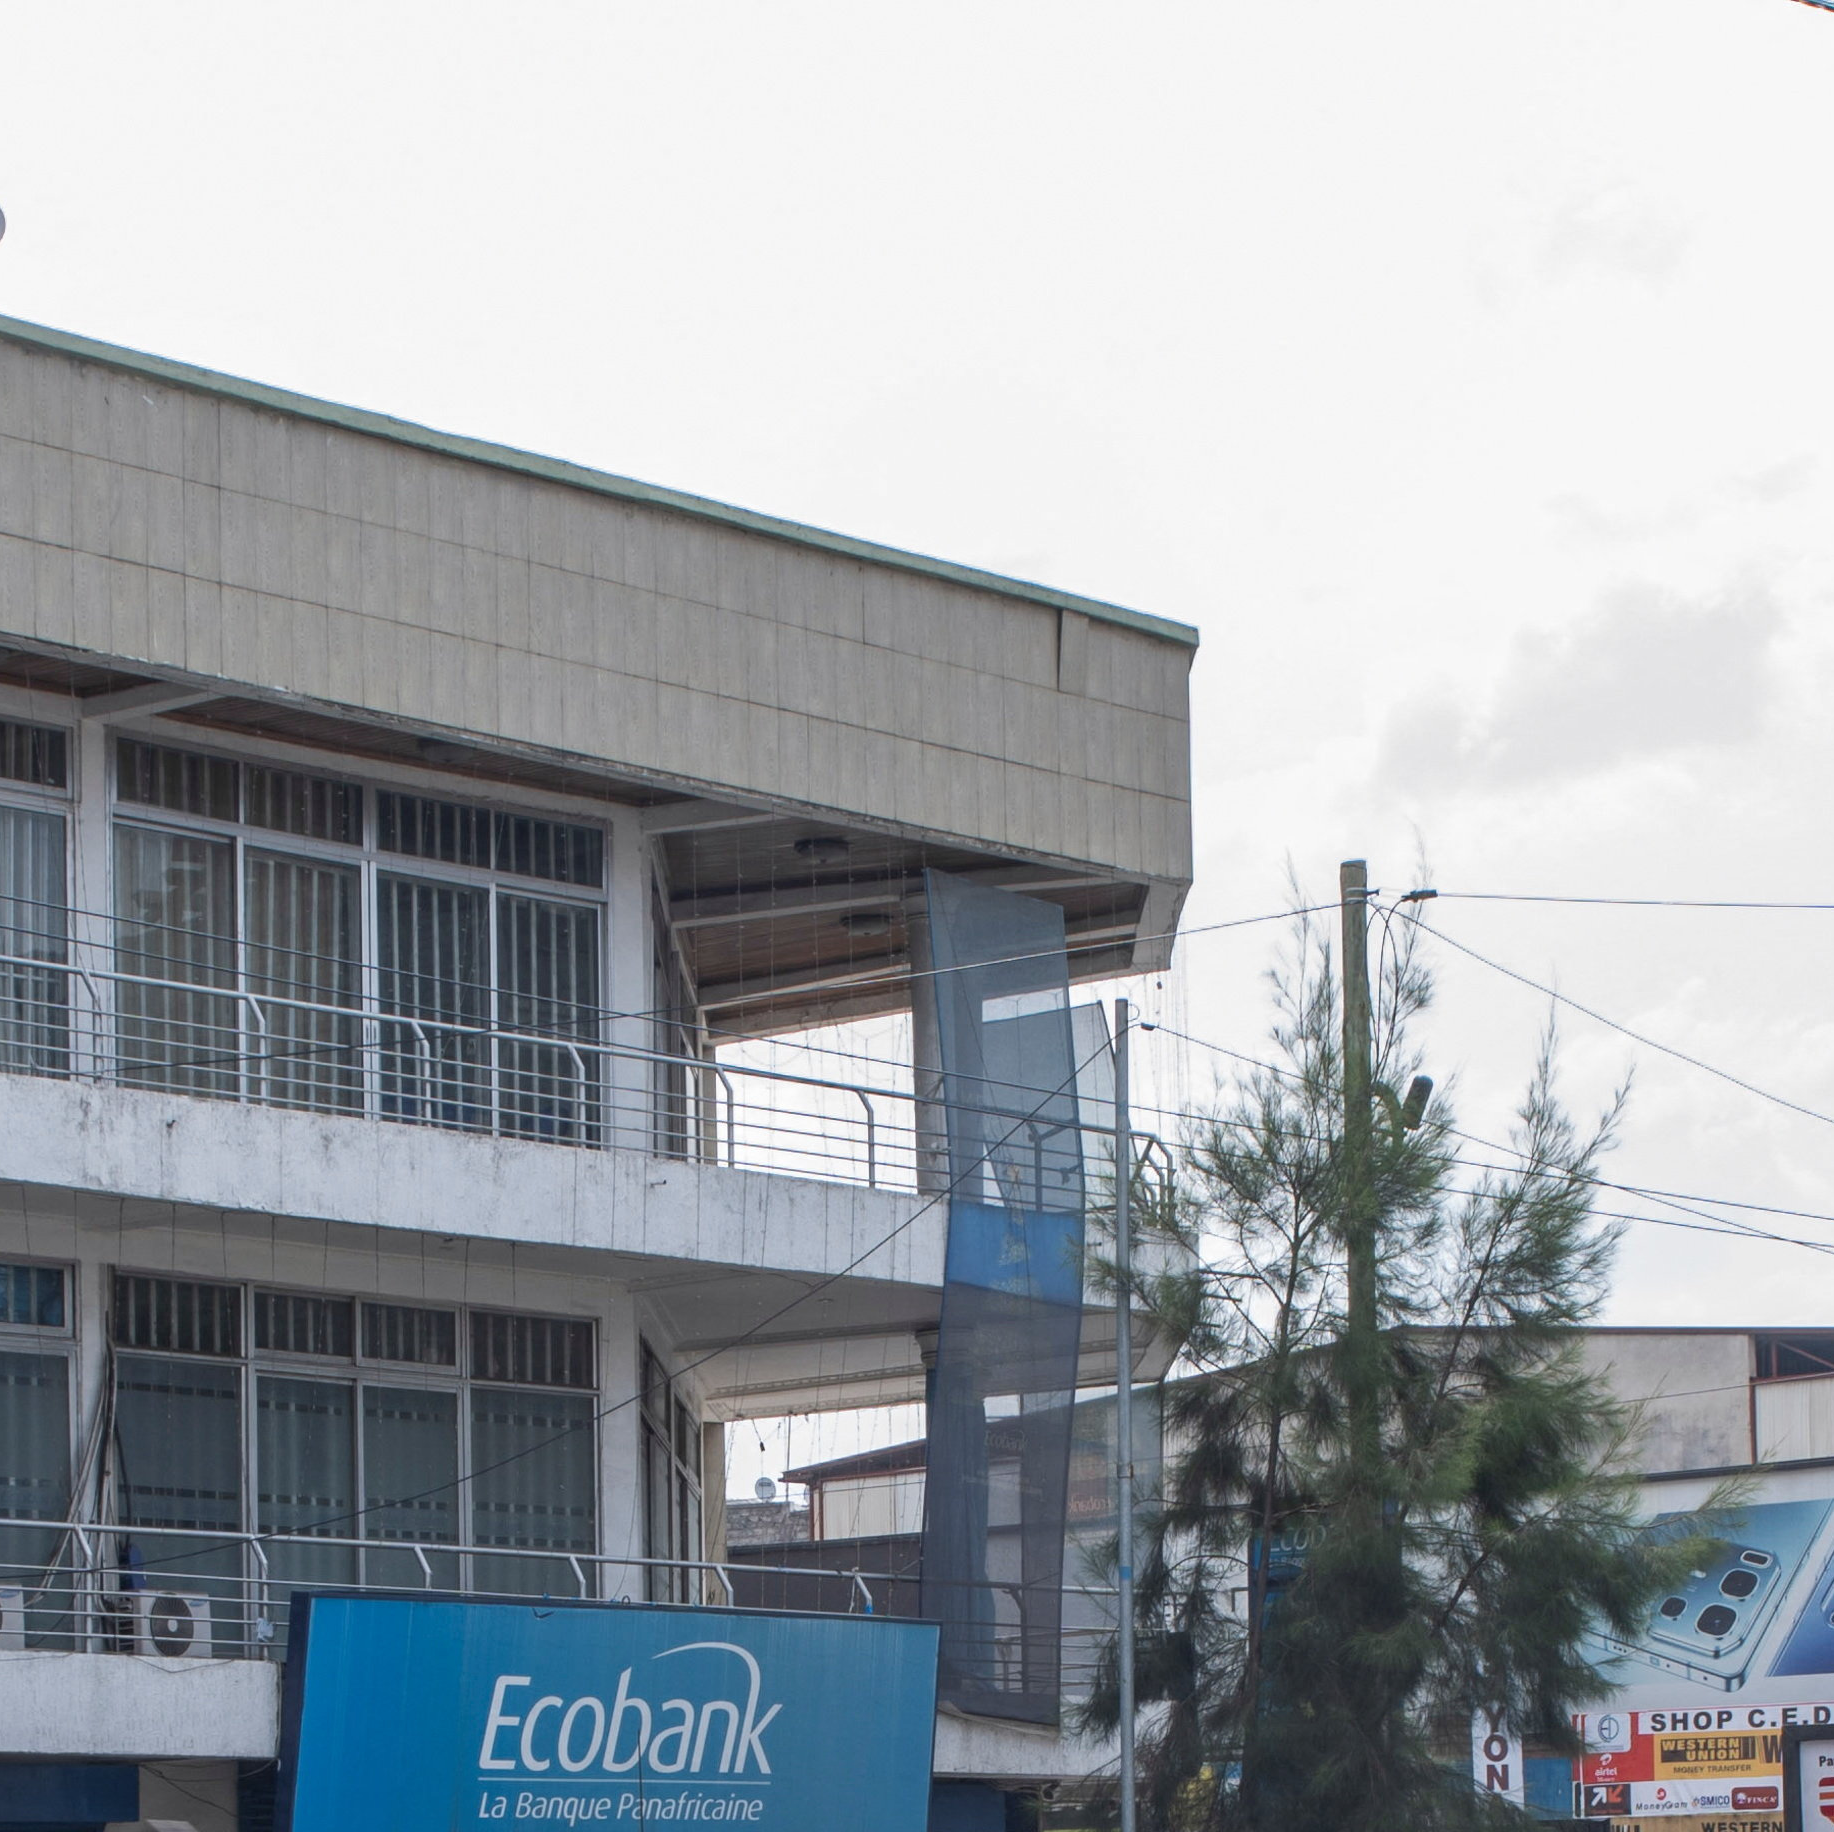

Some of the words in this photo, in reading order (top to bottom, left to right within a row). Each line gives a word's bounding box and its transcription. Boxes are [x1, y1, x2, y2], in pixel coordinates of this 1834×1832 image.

[478, 1641, 783, 1775] Ecobank
[1650, 1709, 1733, 1732] SHOP
[1747, 1705, 1831, 1728] C.E.D
[1661, 1737, 1740, 1751] WESTERN
[1685, 1749, 1740, 1761] UNION
[1595, 1767, 1617, 1776] airtel
[1673, 1765, 1706, 1774] MONEY
[1708, 1764, 1751, 1773] TRANSFER
[1635, 1801, 1688, 1811] MoneyGram
[1700, 1796, 1729, 1806] SMICO
[478, 1791, 507, 1819] La
[515, 1791, 611, 1827] Banque
[616, 1791, 763, 1821] Panafricaine
